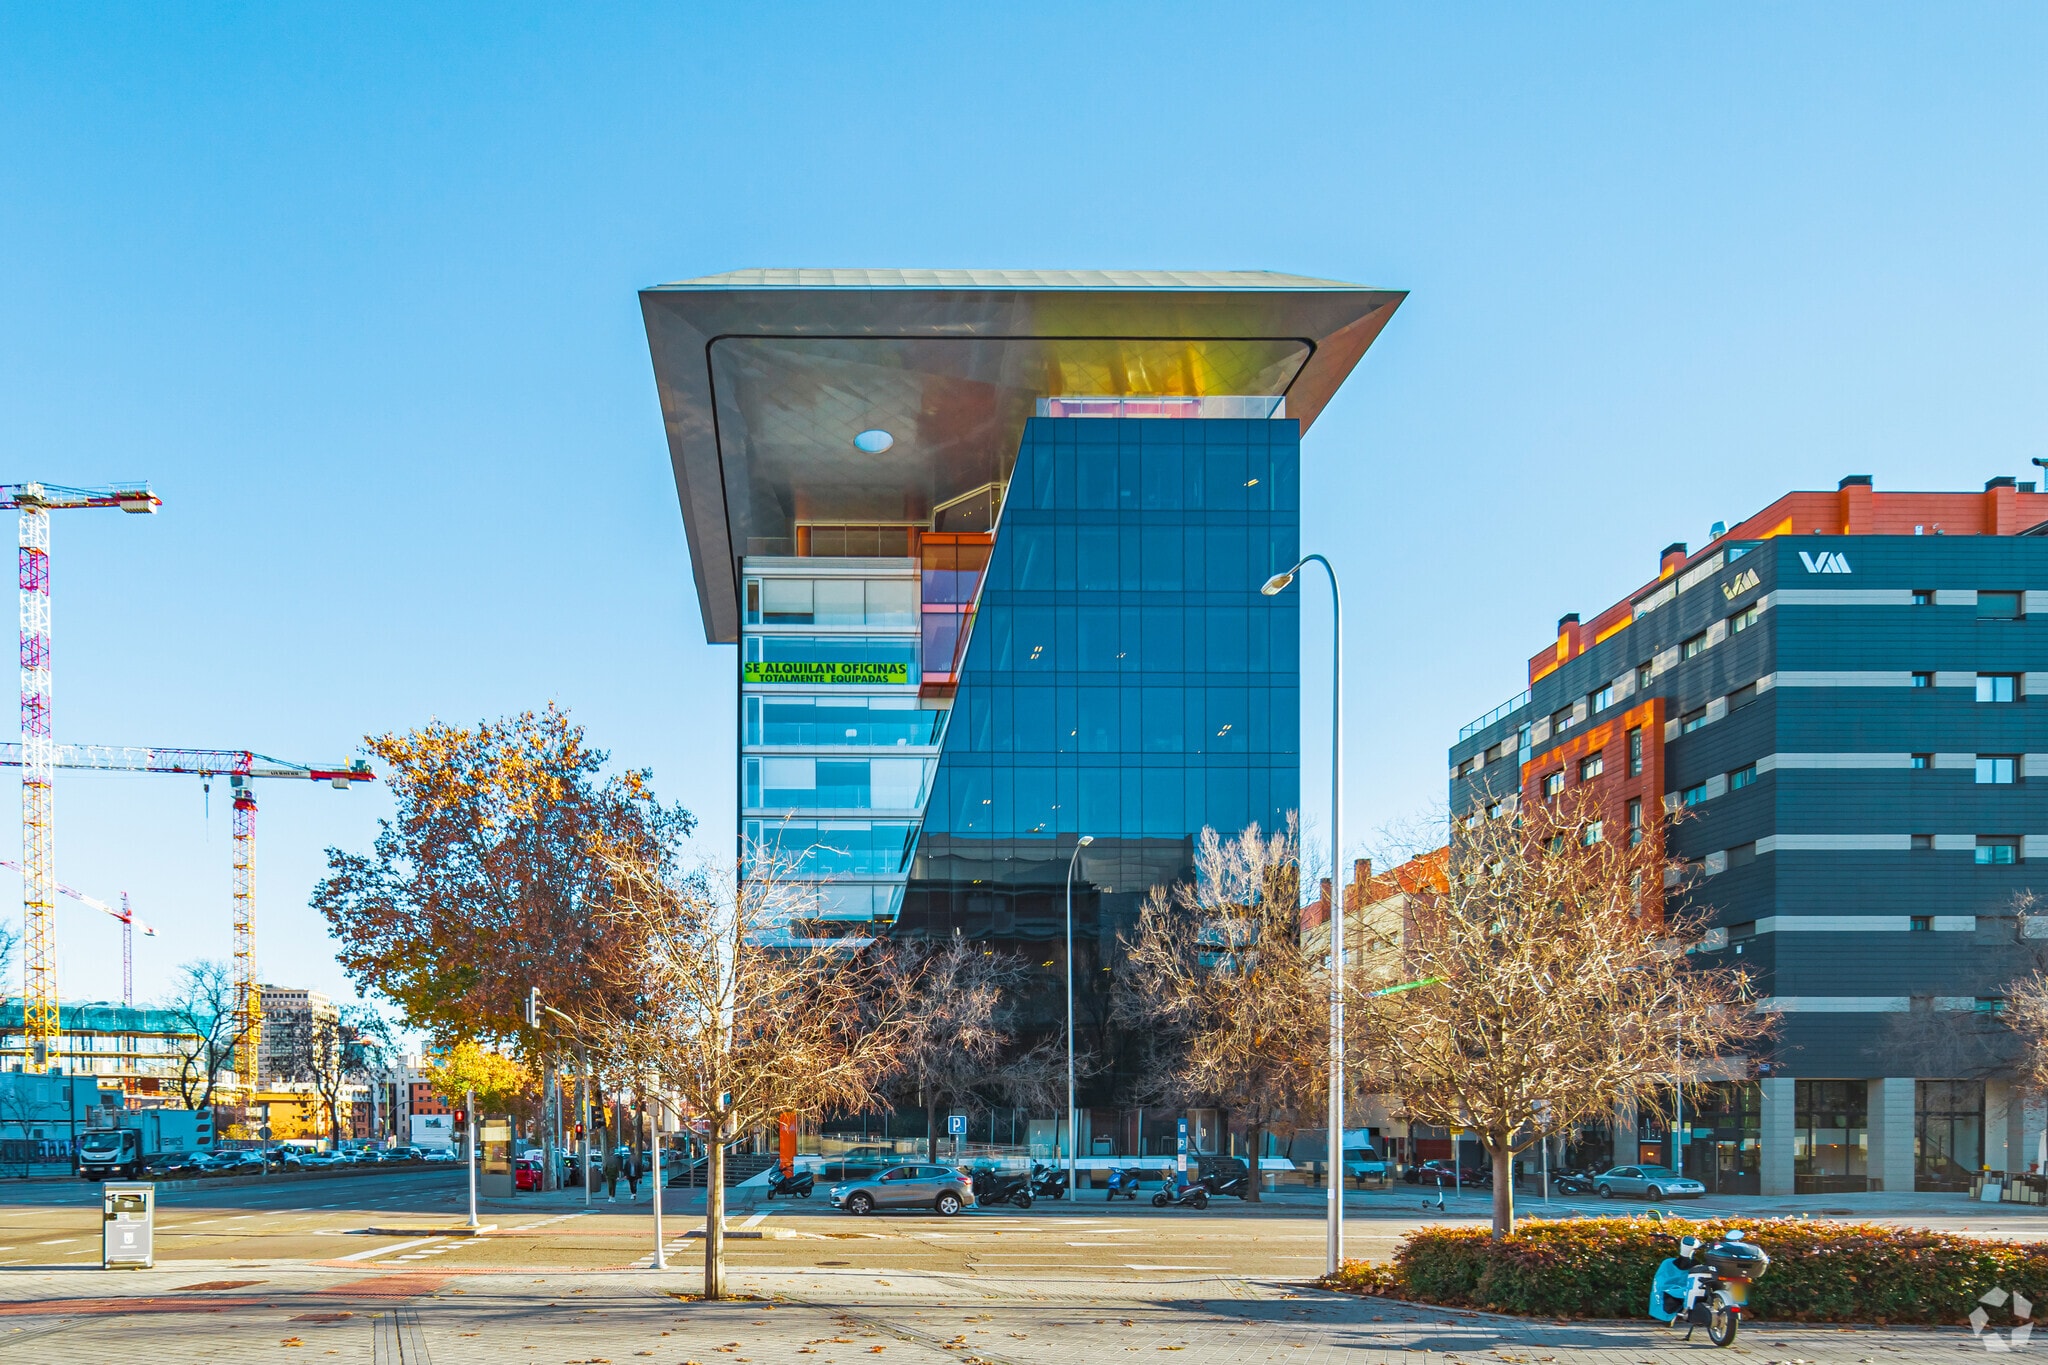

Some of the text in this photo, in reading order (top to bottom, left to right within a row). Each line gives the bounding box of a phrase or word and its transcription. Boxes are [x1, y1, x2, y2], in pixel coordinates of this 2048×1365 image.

[744, 663, 907, 674] SE ALQUILAN OFICINAS
[759, 674, 889, 683] TOTALMENTE EQUIPADAS
[952, 1117, 961, 1132] P
